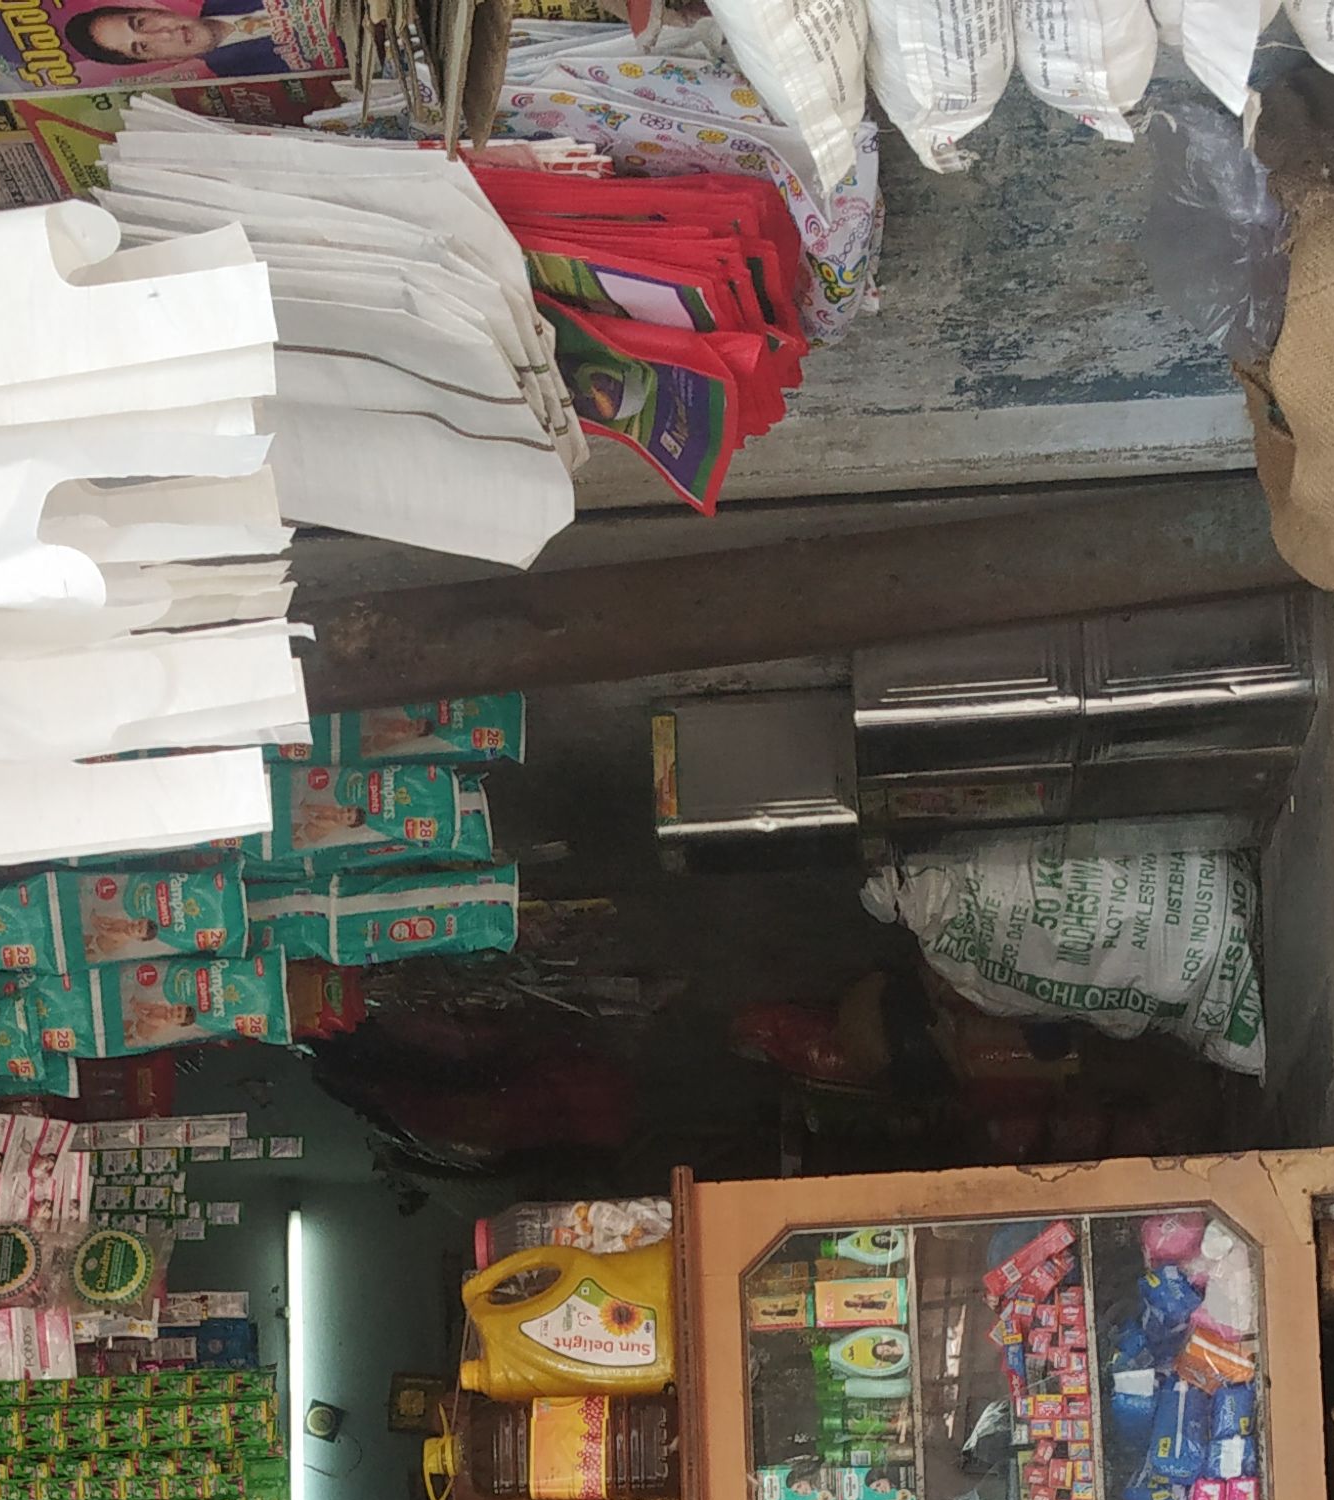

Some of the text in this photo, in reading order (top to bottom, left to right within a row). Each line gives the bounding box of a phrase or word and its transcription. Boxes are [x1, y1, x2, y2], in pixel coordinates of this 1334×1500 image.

[1031, 898, 1061, 930] 50
[1103, 904, 1125, 950] PLOT
[1180, 945, 1206, 982] FOR
[1218, 926, 1248, 982] USE
[1035, 977, 1159, 1016] CHLORIDE
[554, 1335, 651, 1356] Sun Delight
